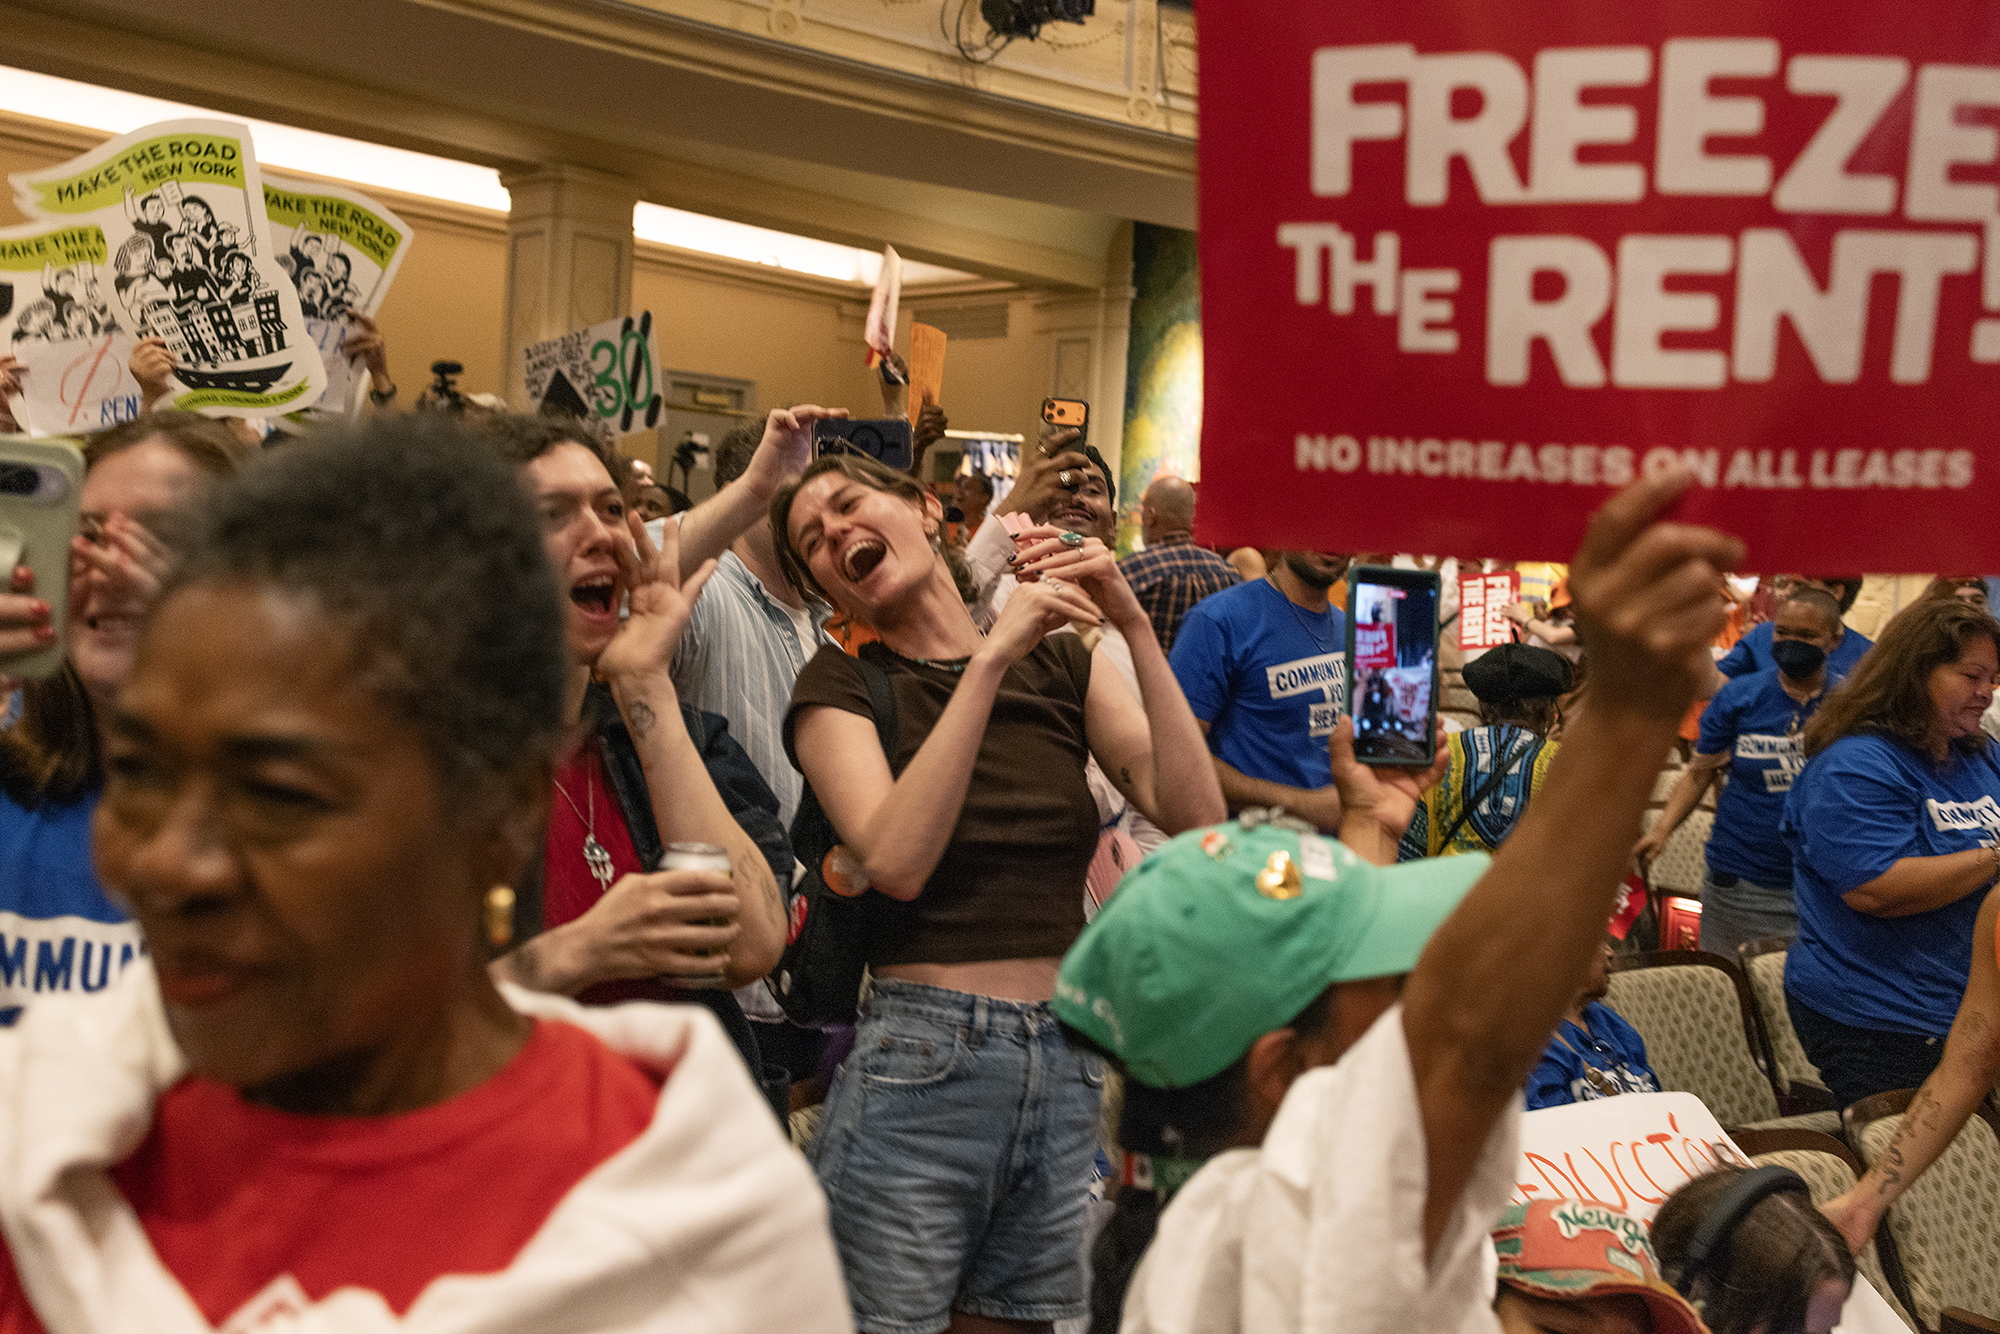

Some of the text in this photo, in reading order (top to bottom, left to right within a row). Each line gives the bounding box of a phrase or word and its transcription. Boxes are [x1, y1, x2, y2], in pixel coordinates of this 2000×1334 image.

[1310, 38, 2000, 223] FREEZE
[56, 139, 237, 203] MAKE THE ROAD
[141, 160, 237, 185] NEW YORK
[311, 199, 346, 218] THE
[350, 208, 396, 248] ROAD
[319, 217, 388, 260] NEW YORK
[1277, 222, 1461, 353] THE
[1295, 434, 1975, 490] NO INCREASES ON ALL LEASES
[1462, 577, 1485, 646] THE RENT
[1485, 575, 1511, 646] FREEZE
